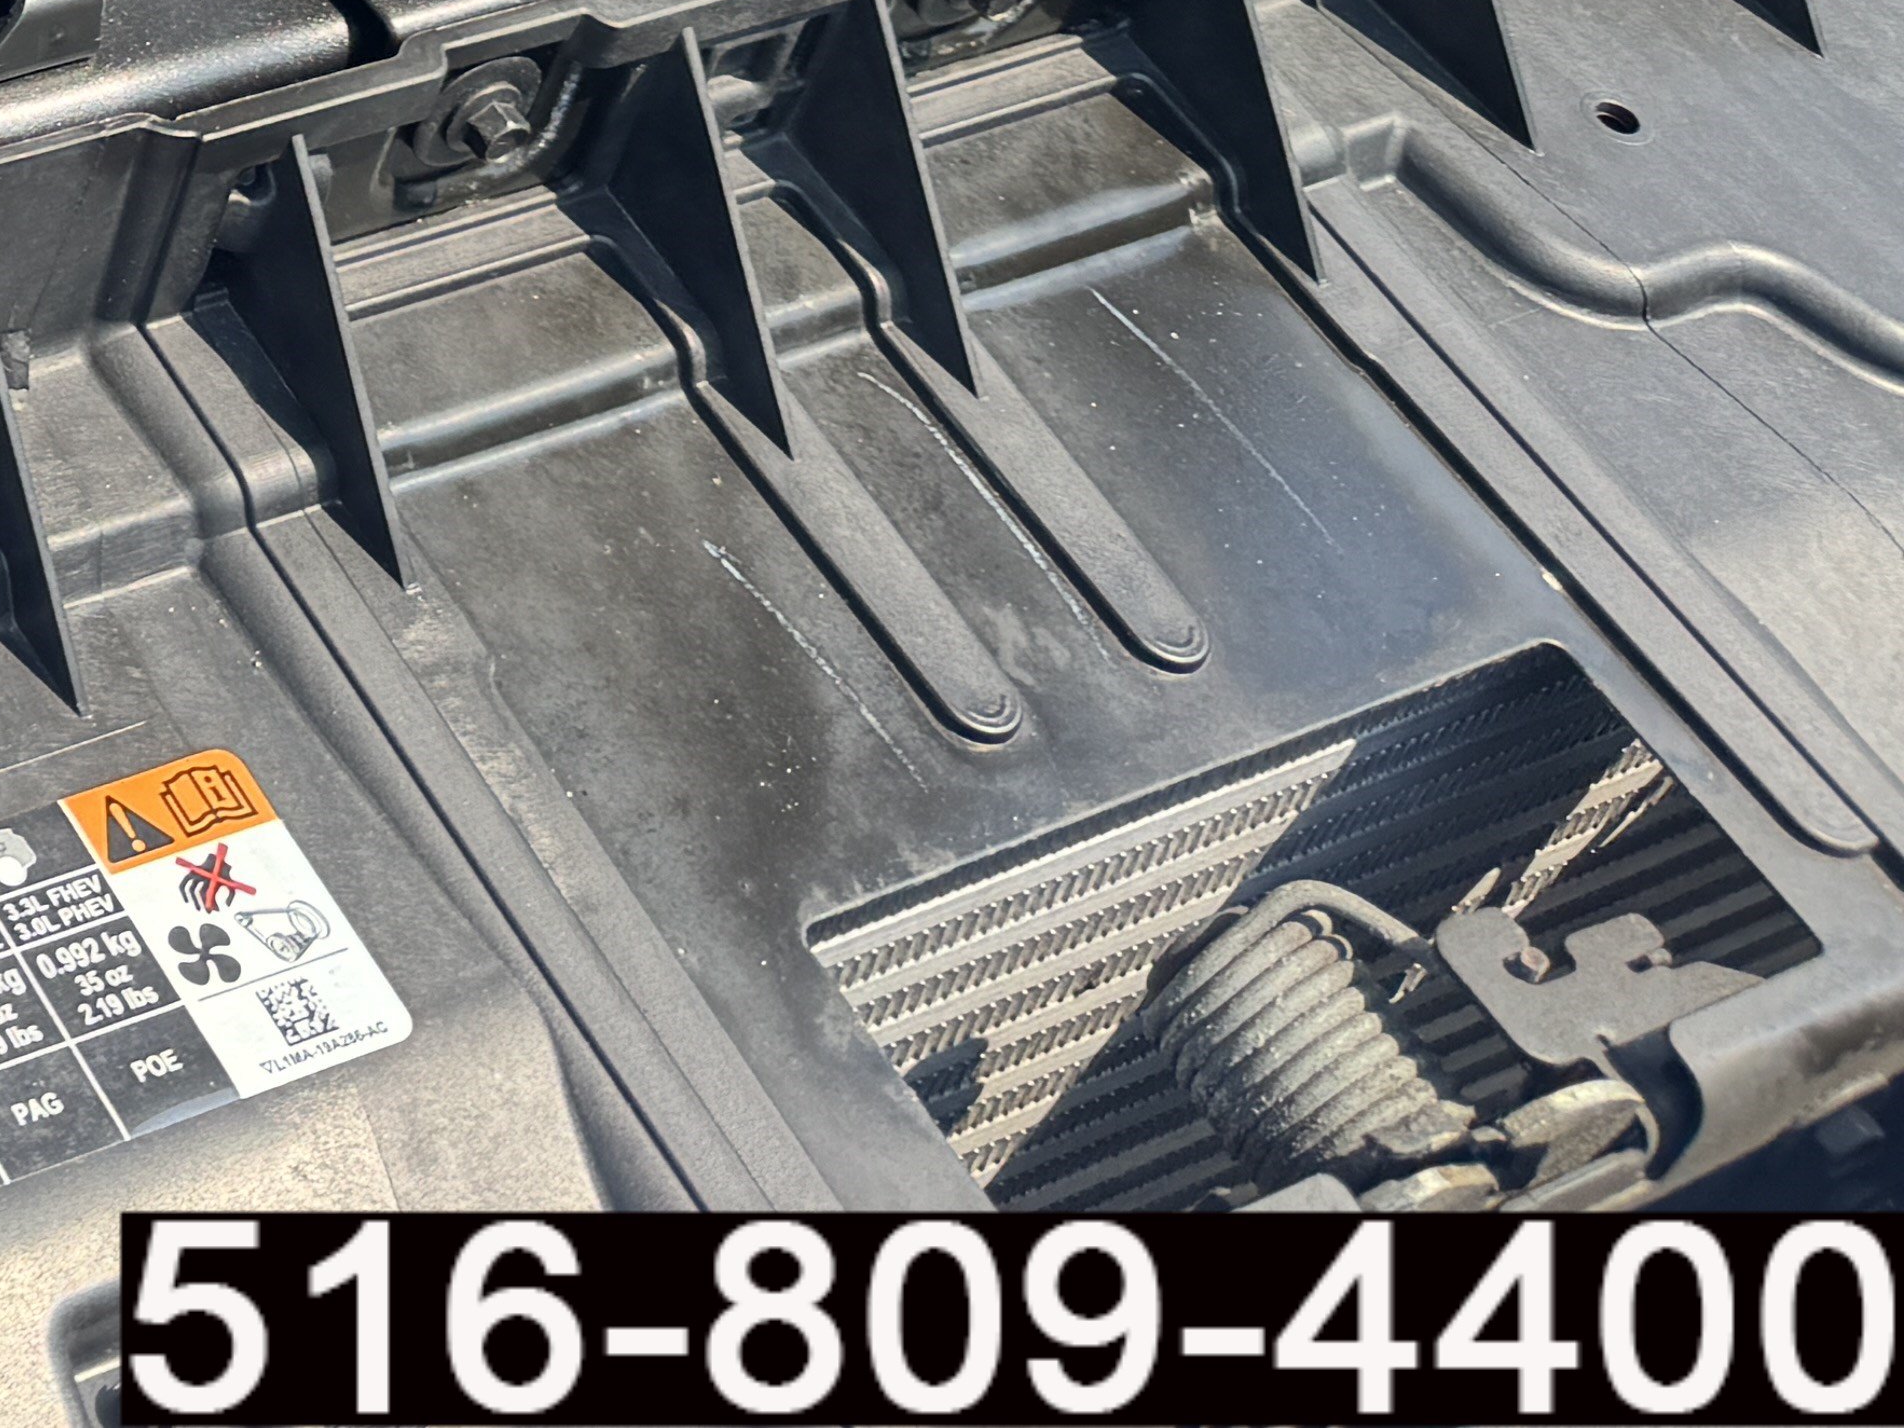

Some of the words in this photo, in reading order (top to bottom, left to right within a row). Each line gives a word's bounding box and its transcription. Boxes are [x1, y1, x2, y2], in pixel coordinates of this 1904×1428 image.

[2, 894, 51, 922] 3.3L
[45, 873, 103, 908] FHEV
[13, 914, 62, 942] 3.0L
[57, 893, 116, 927] PHEV
[35, 937, 108, 980] 0.992
[100, 928, 143, 959] kg
[73, 969, 106, 998] 35
[104, 963, 135, 988] oz
[77, 995, 126, 1027] 2.19
[120, 984, 160, 1012] lbs
[5, 1024, 45, 1050] lbs
[129, 1048, 185, 1084] POE
[10, 1092, 65, 1127] PAG
